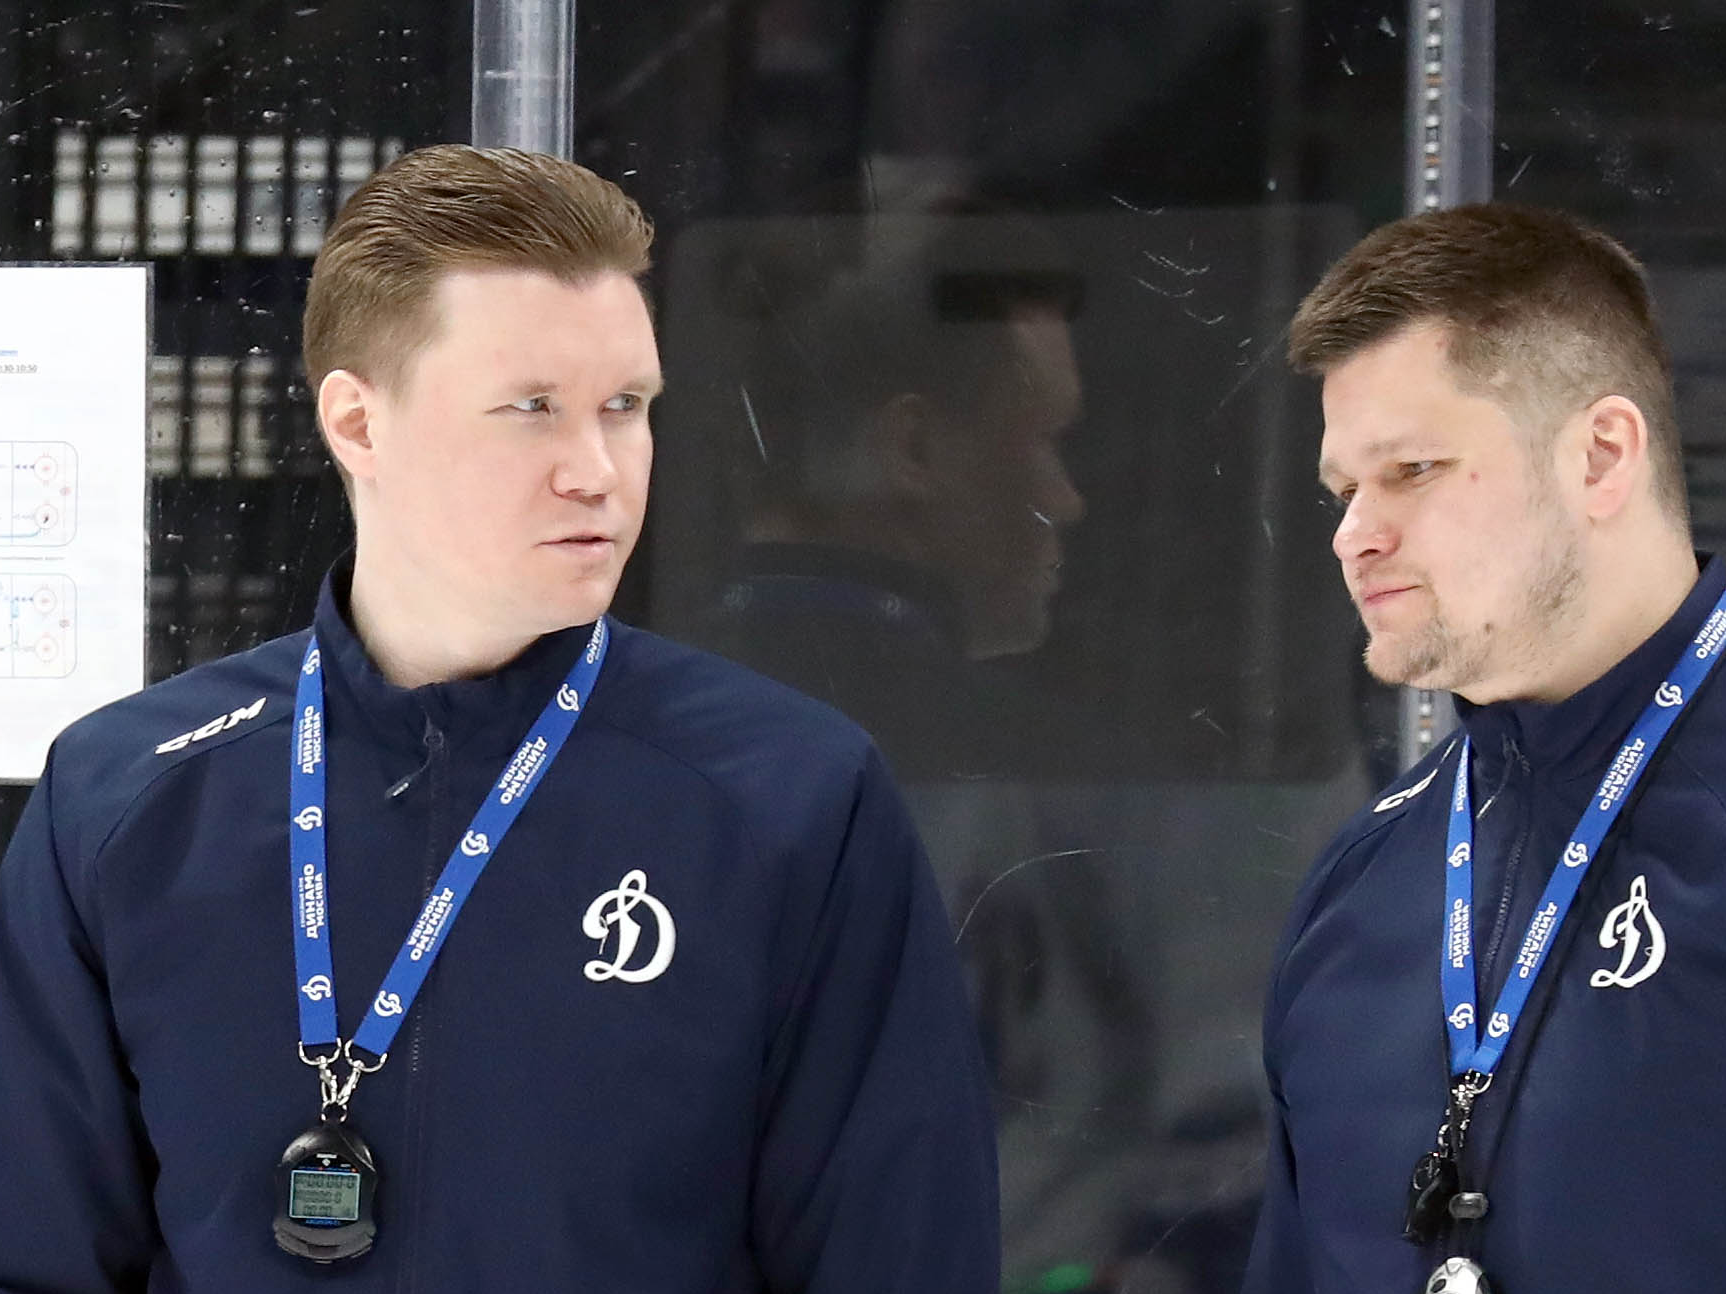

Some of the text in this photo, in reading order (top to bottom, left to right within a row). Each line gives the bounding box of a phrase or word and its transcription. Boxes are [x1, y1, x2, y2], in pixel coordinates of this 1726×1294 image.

[155, 697, 266, 755] CCM
[302, 705, 314, 774] ДИНАМО
[497, 741, 534, 789] МОСКВА
[500, 736, 547, 804] ДИНАМО
[1598, 745, 1633, 797] МОСКВА
[1599, 738, 1646, 811] ДИНАМО
[304, 864, 318, 938] ДИНАМО
[314, 872, 325, 927] МОСКВА
[407, 895, 440, 946] МОСКВА
[410, 887, 454, 961] ДИНАМО
[1516, 910, 1550, 964] МОСКВА
[1519, 902, 1558, 978] ДИНАМО
